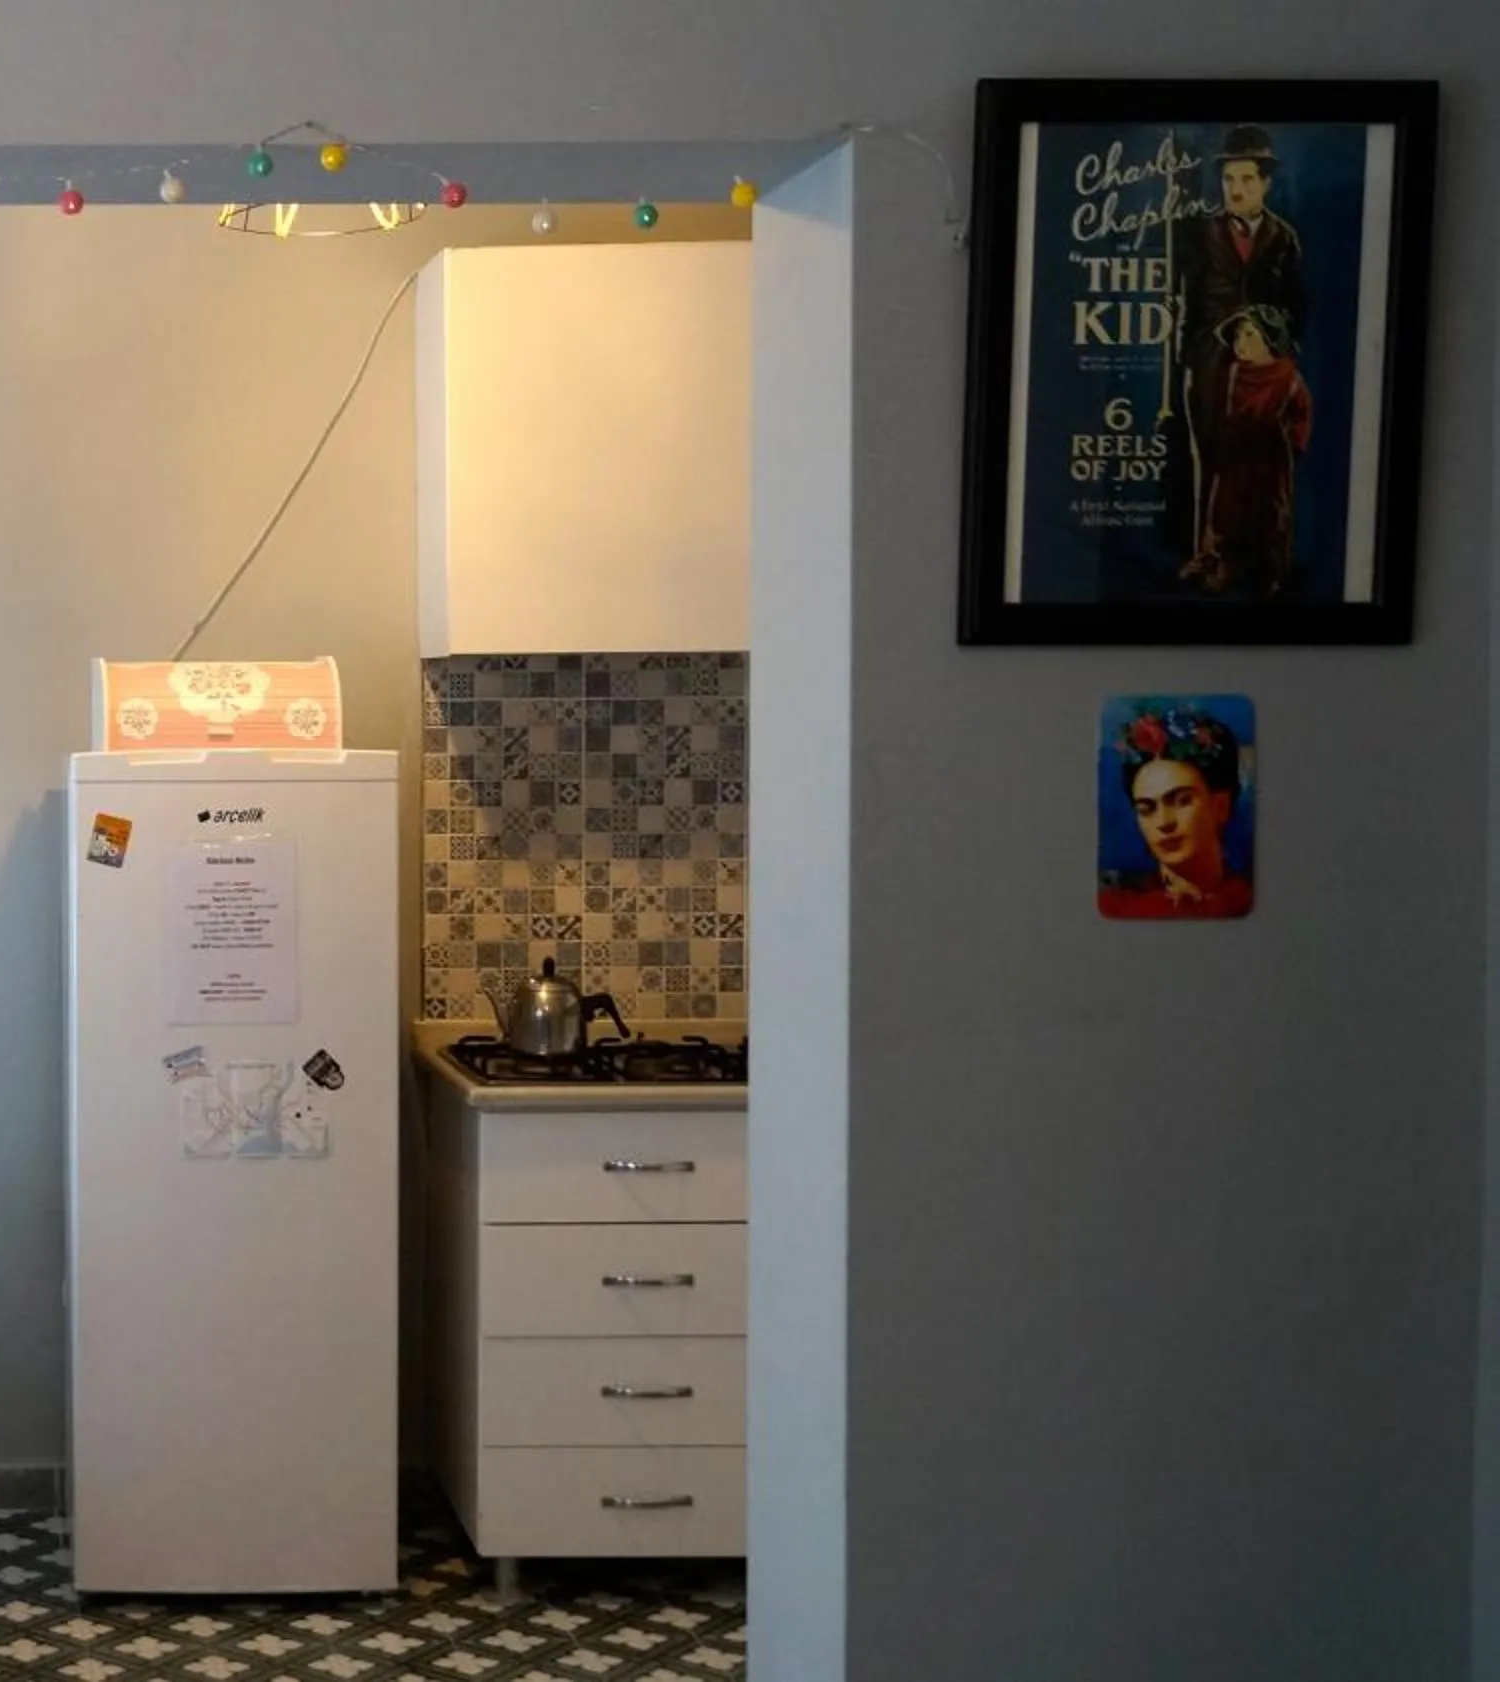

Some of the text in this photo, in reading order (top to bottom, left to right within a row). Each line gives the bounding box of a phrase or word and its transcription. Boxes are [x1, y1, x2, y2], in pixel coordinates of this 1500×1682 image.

[1075, 139, 1202, 195] Charles
[1072, 185, 1220, 250] Chaplin
[1104, 397, 1134, 431] 6
[1071, 434, 1168, 457] REELS
[1069, 460, 1167, 481] OF JOY
